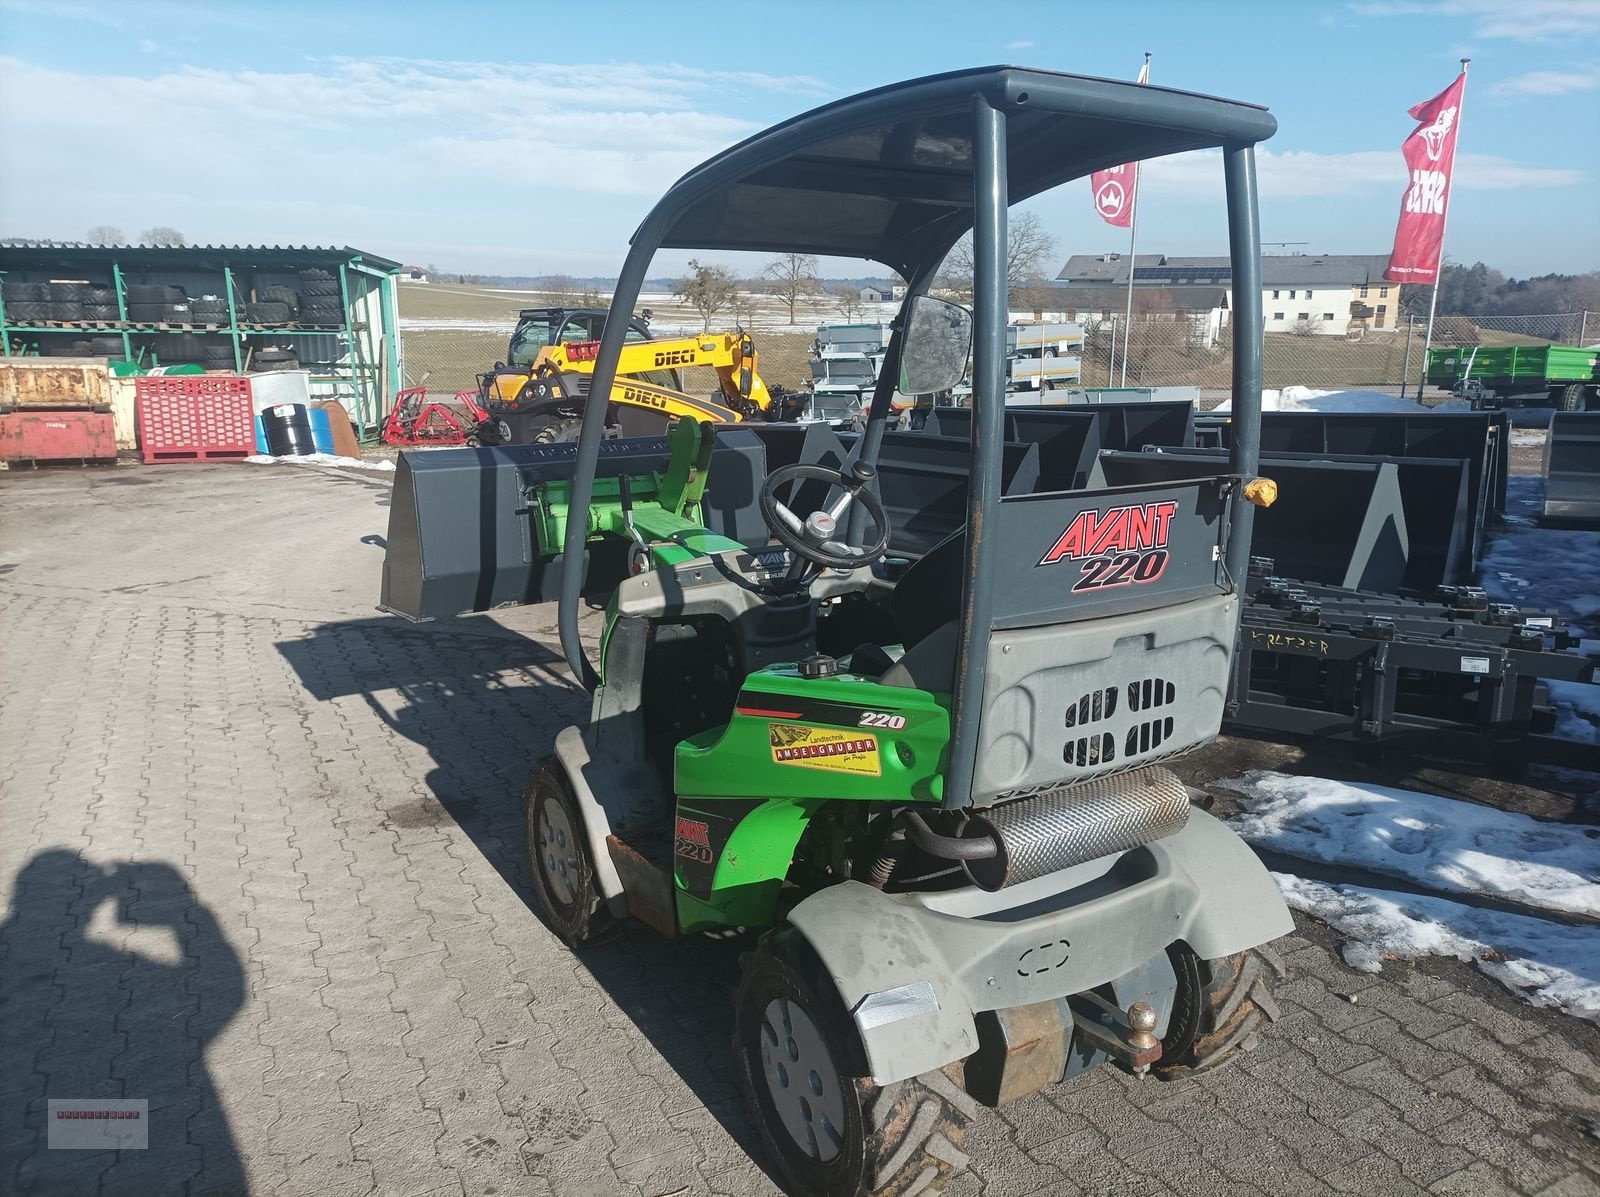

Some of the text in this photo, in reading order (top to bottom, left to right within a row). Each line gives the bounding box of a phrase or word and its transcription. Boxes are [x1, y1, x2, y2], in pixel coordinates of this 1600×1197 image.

[655, 349, 695, 367] DIECI
[624, 387, 667, 408] DIECI
[1034, 500, 1177, 567] AVANT
[1071, 550, 1170, 594] 220
[858, 712, 906, 730] 220
[810, 735, 845, 744] Landtechnik
[776, 740, 875, 760] AMSELGRUBER
[675, 839, 713, 864] 220
